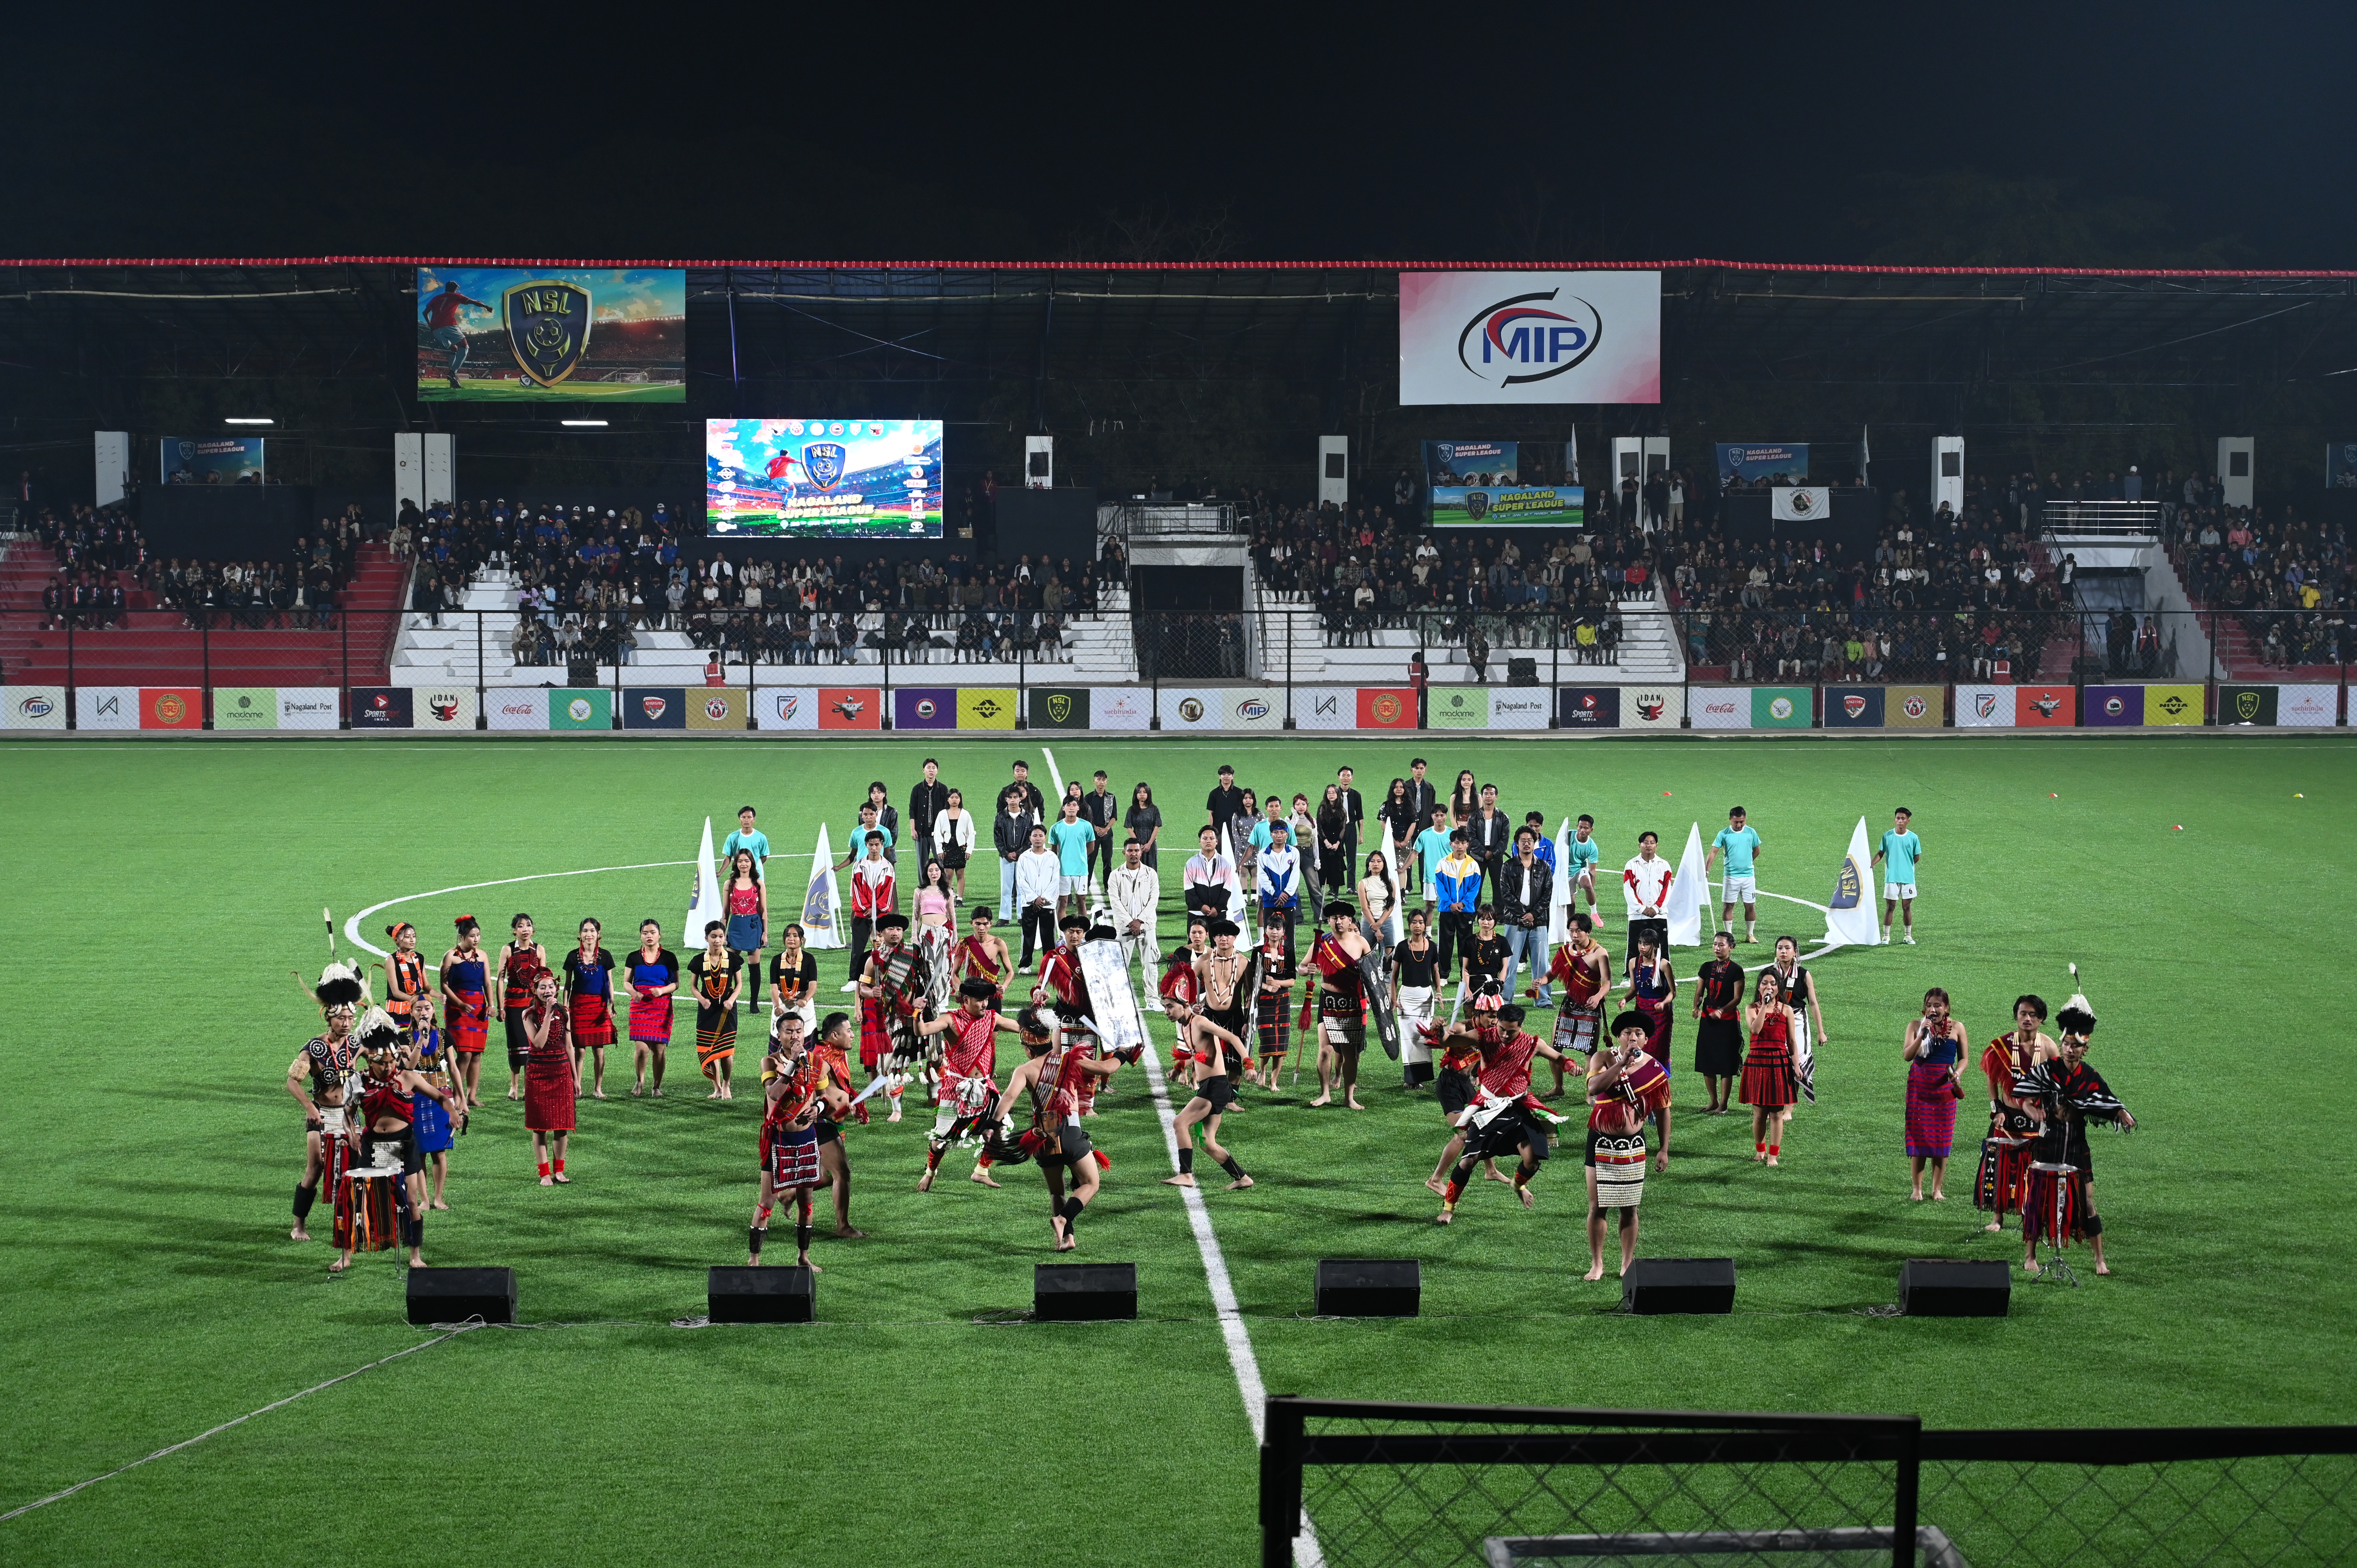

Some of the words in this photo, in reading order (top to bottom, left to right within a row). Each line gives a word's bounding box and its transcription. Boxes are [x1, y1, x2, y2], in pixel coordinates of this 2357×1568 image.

[439, 297, 448, 311] 7
[522, 290, 572, 315] NSL
[1482, 316, 1587, 363] MIP
[811, 445, 837, 459] NSL
[787, 494, 863, 507] NAGALAND
[1500, 490, 1555, 501] NAGALAND
[776, 508, 820, 519] SUPER
[820, 504, 875, 516] LEAGUE
[1492, 501, 1525, 512] SUPER
[1525, 499, 1564, 510] LEAGUE
[157, 696, 168, 705] ROYAL
[168, 695, 183, 705] ENFIELD
[1374, 695, 1385, 705] ROYAL
[1385, 695, 1399, 705] ENFIELD
[25, 702, 51, 713] MIP
[291, 703, 316, 712] Nagaland
[1242, 705, 1267, 715] MIP
[1706, 703, 1736, 713] Coca-Cola
[1840, 865, 1857, 899] NSL
